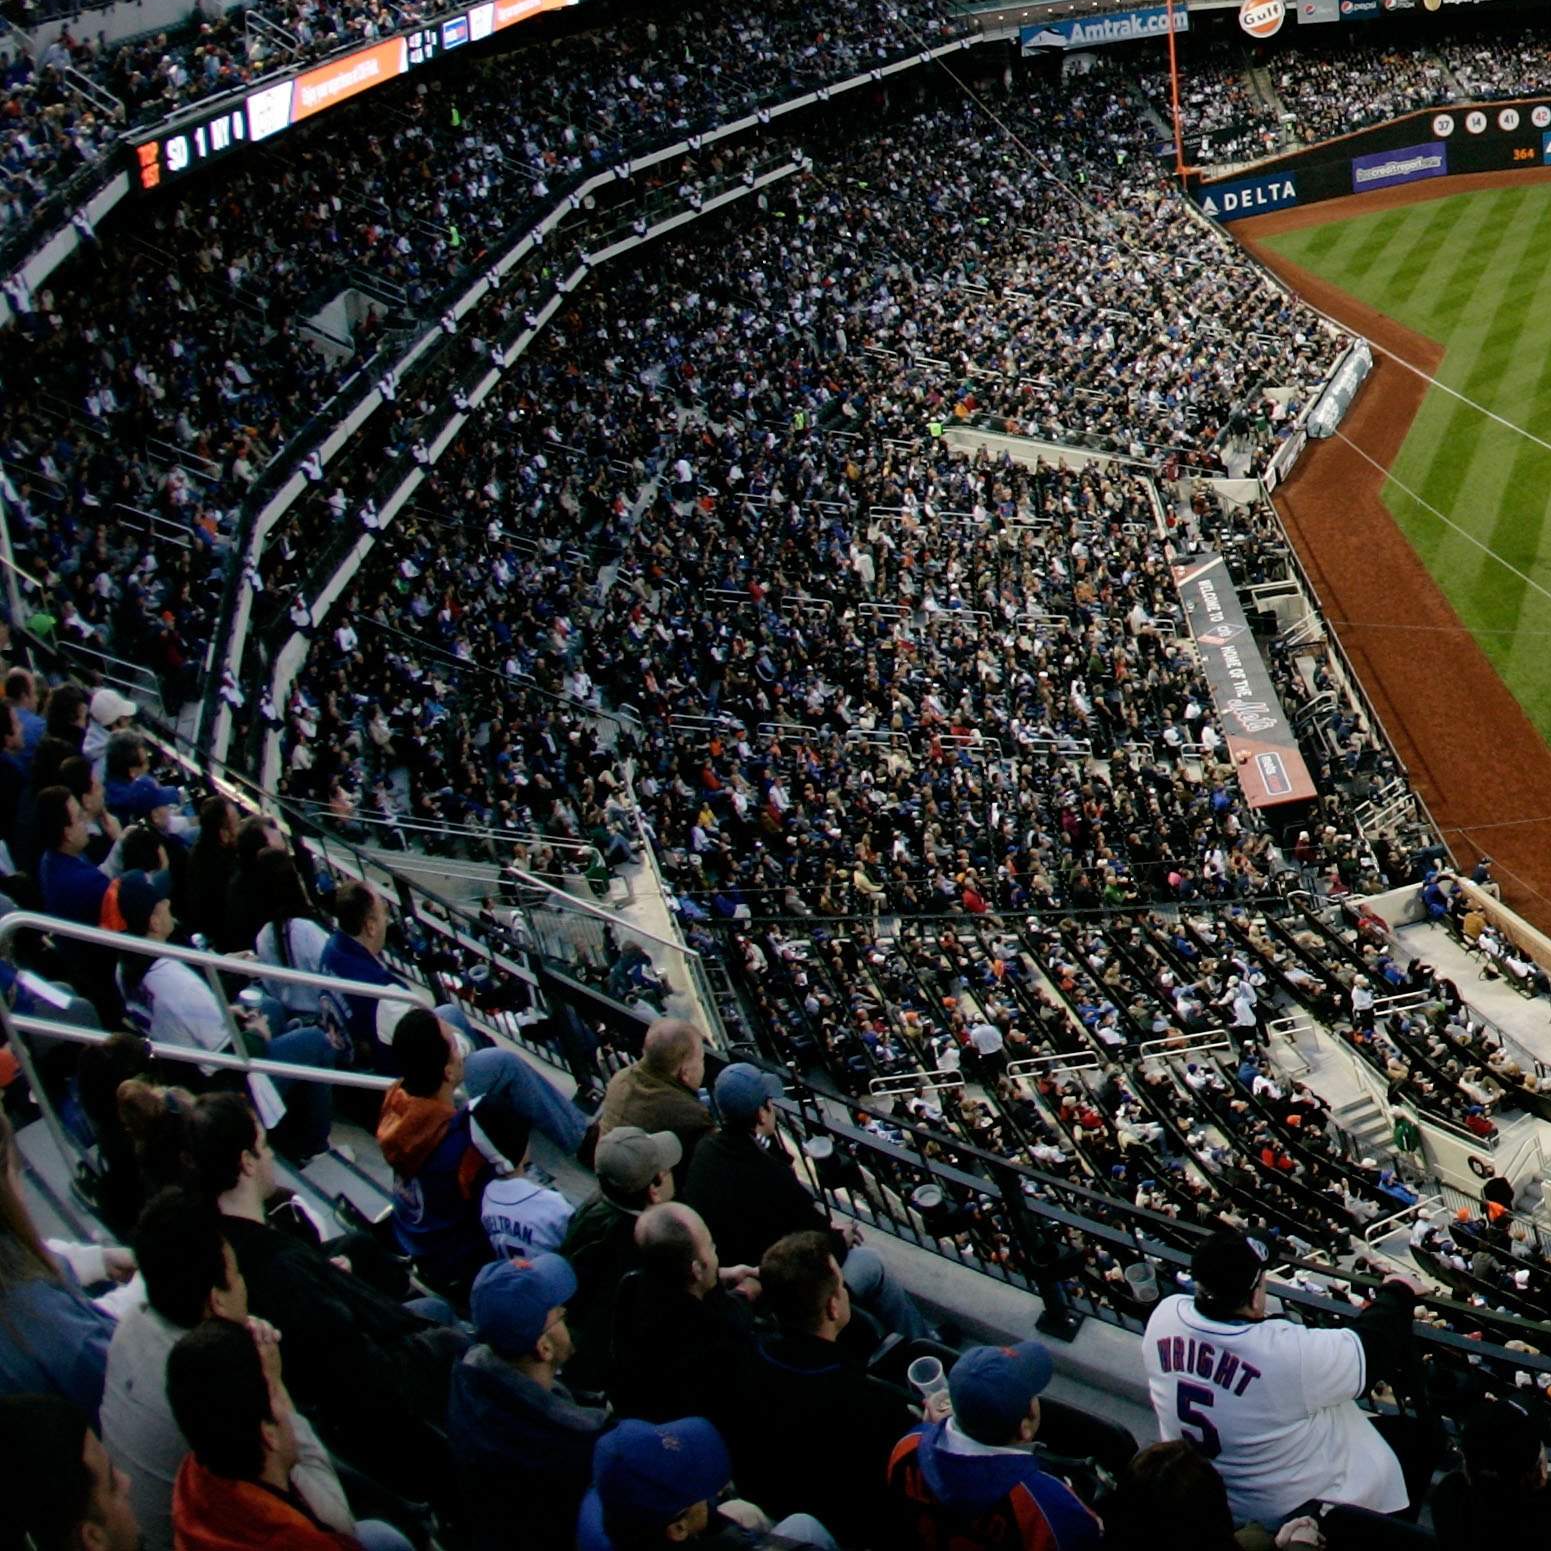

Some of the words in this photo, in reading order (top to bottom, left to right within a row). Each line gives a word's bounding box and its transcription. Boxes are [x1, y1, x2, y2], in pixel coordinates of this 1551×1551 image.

[1070, 9, 1188, 44] Amtrak.com
[1243, 4, 1281, 27] Gulf
[1437, 119, 1449, 131] 37
[1472, 117, 1482, 128] 14
[1504, 114, 1515, 126] 41
[1535, 111, 1548, 122] 42
[1513, 148, 1535, 161] 364
[1224, 179, 1296, 211] DELTA
[1198, 579, 1220, 612] WELCOME
[1209, 609, 1224, 622] TO
[1220, 645, 1241, 669] HOME
[1233, 679, 1253, 697] THE
[1226, 698, 1278, 733] Mets
[481, 1215, 533, 1245] BELTRAN
[1157, 1336, 1261, 1397] WRIGHT
[1177, 1380, 1222, 1460] 5
